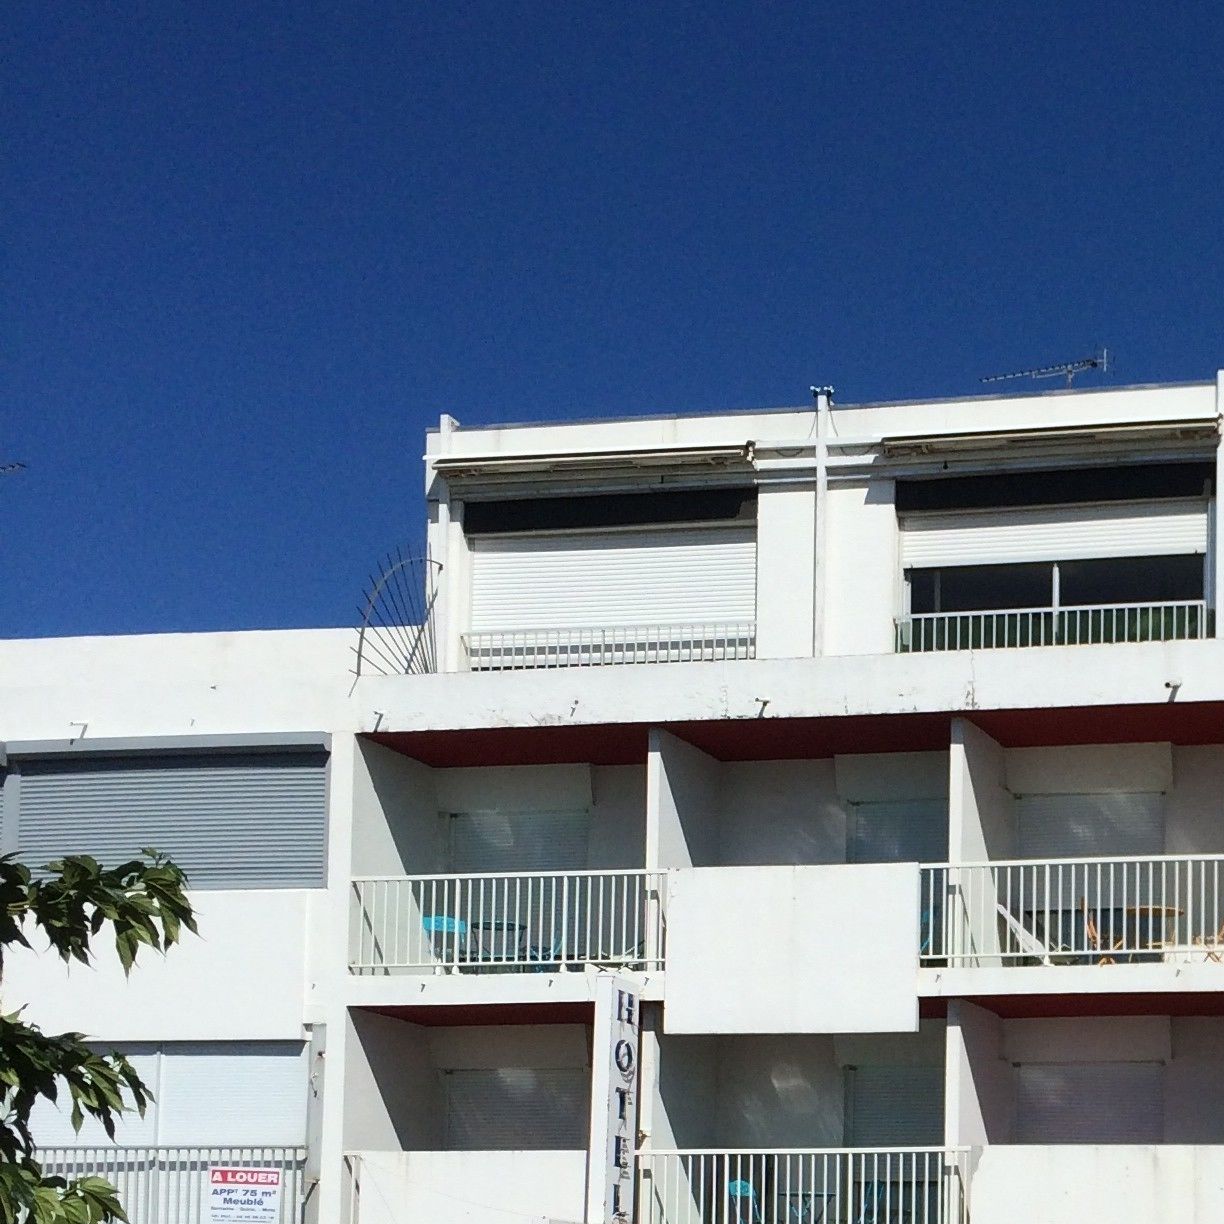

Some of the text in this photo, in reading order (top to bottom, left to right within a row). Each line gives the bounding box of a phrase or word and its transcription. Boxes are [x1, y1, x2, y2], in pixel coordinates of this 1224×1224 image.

[612, 989, 635, 1219] HOTEL
[212, 1171, 279, 1184] A LOUER
[242, 1189, 257, 1197] 75
[223, 1197, 264, 1206] Meublé
